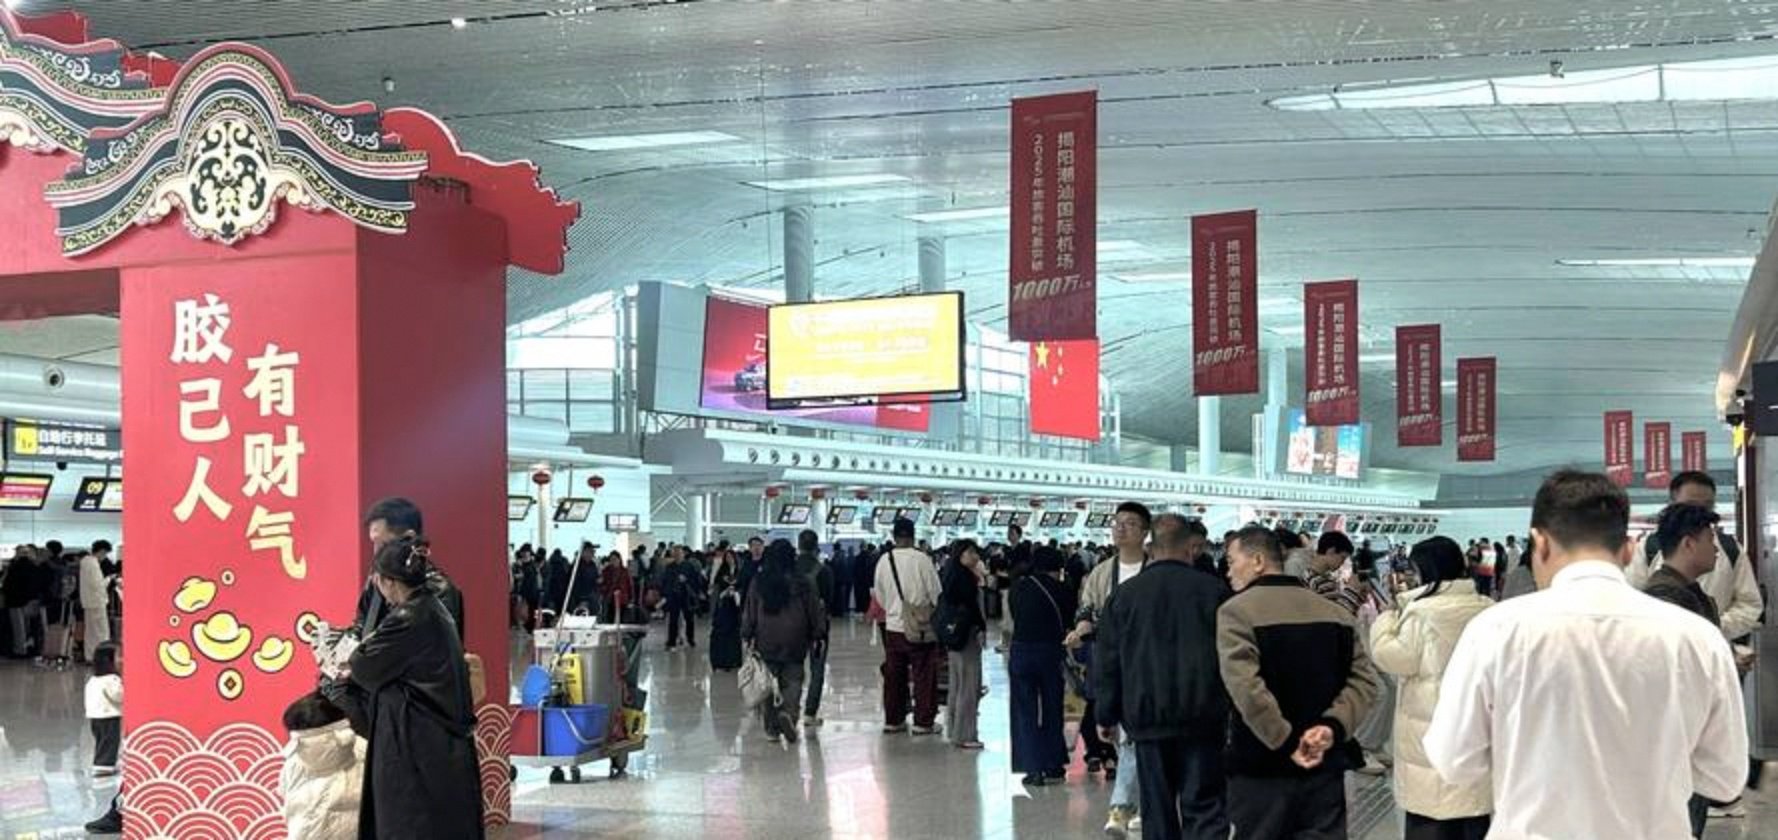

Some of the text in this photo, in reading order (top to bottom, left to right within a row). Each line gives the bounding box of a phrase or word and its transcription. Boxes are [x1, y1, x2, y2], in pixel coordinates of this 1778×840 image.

[1056, 131, 1076, 269] 揭阳潮汕国际机场
[170, 295, 233, 524] 胶己人
[241, 343, 307, 580] 有财气
